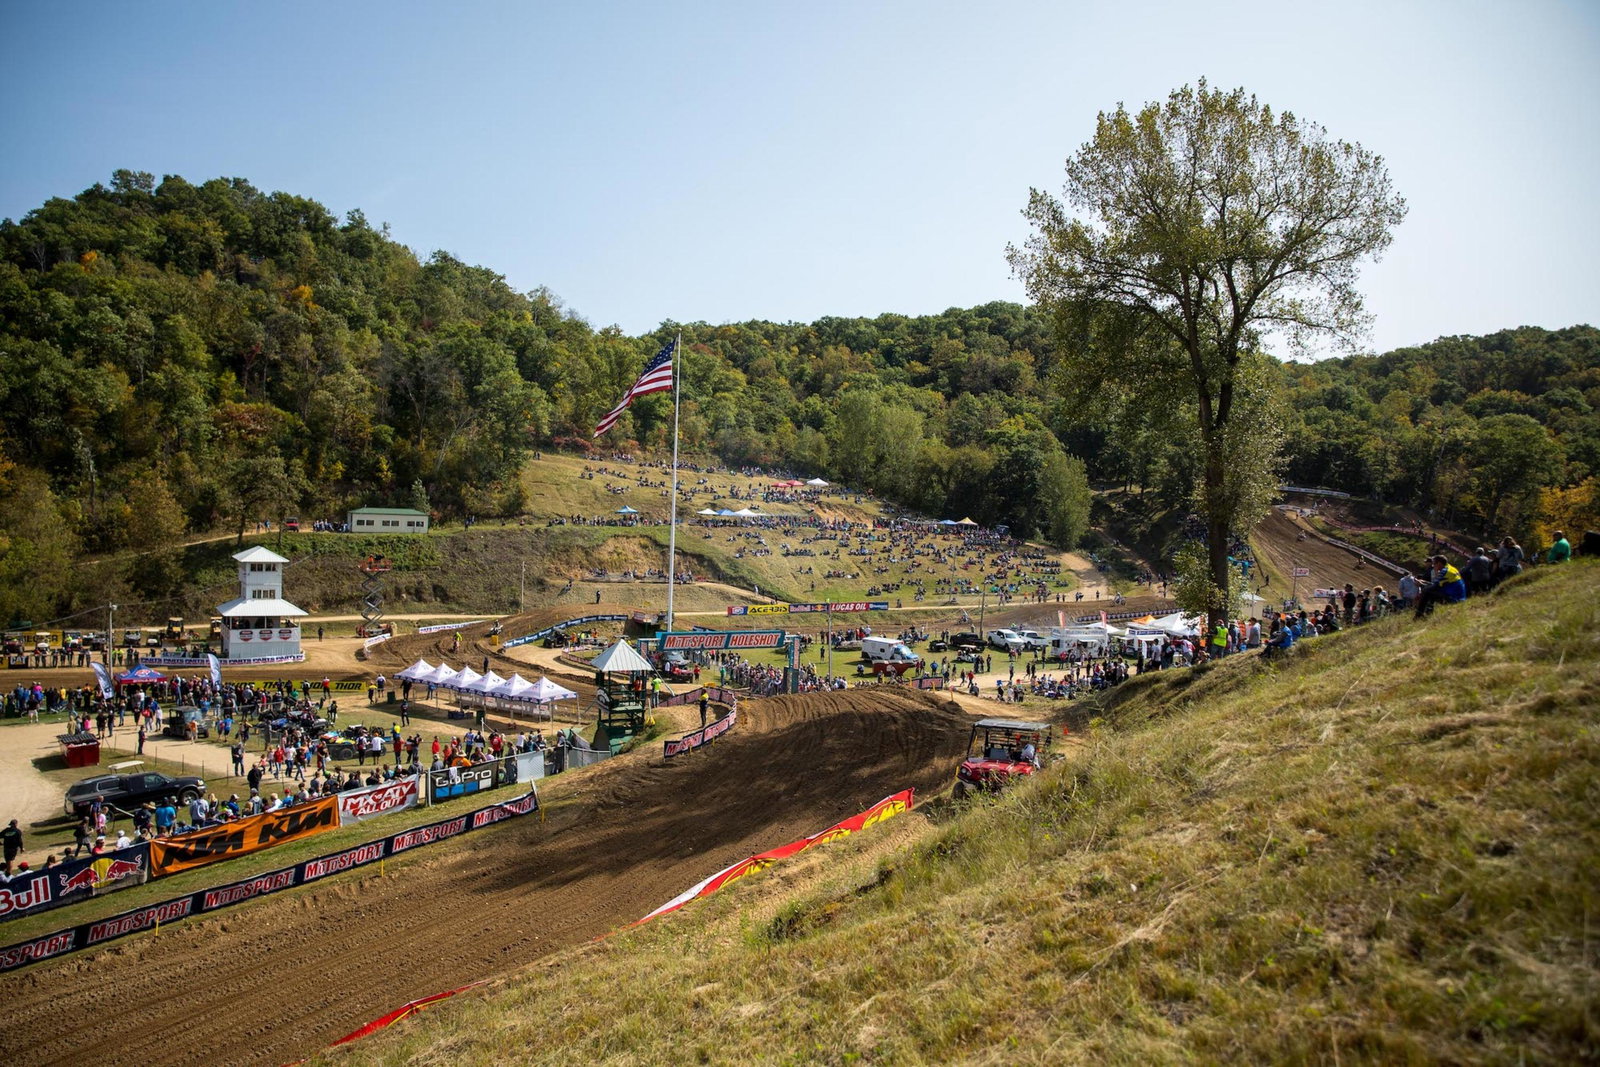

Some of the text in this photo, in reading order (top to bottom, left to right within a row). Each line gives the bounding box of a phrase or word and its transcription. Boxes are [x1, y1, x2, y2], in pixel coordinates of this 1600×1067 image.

[831, 602, 854, 611] LUCAS
[855, 602, 867, 610] OIL
[729, 633, 780, 647] HOLESHOT
[335, 682, 362, 690] THOR
[436, 768, 492, 788] GoPro
[345, 791, 377, 812] MX
[381, 782, 414, 801] ATV
[356, 796, 403, 817] ALL OUT
[258, 807, 332, 844] KTM
[160, 830, 245, 868] KTM
[0, 877, 51, 915] Bull
